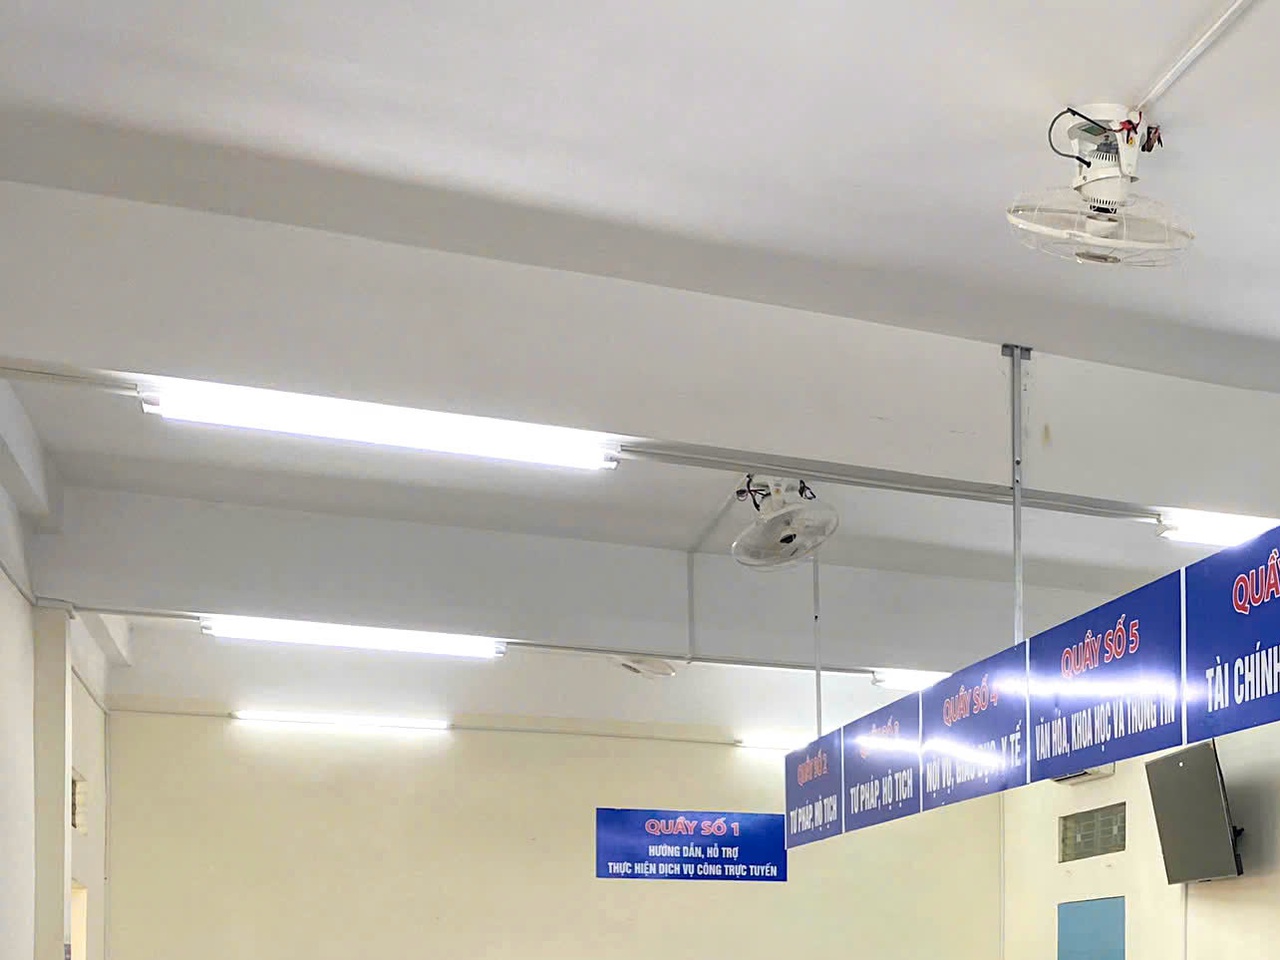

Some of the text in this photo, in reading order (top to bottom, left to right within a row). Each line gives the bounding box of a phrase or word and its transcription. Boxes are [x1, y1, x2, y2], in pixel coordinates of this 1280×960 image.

[1061, 614, 1140, 679] QUẦY SỐ 5
[943, 685, 972, 727] QUẦY
[972, 673, 989, 714] SỐ
[1206, 656, 1229, 712] TÀI
[1009, 719, 1022, 768] TẾ
[1035, 716, 1051, 761] VĂN
[1071, 708, 1093, 751] KHOA
[1094, 702, 1111, 752] HỌC
[850, 768, 913, 814] TƯ PHÁP, HỘ TỊCH
[645, 816, 740, 836] QUẦY SỐ 1
[607, 861, 778, 878] THỰC HIỆN DỊCH VỤ CÔNG TRỰC TUYẾN
[648, 843, 680, 858] HƯỚNG
[721, 846, 739, 861] TRỢ
